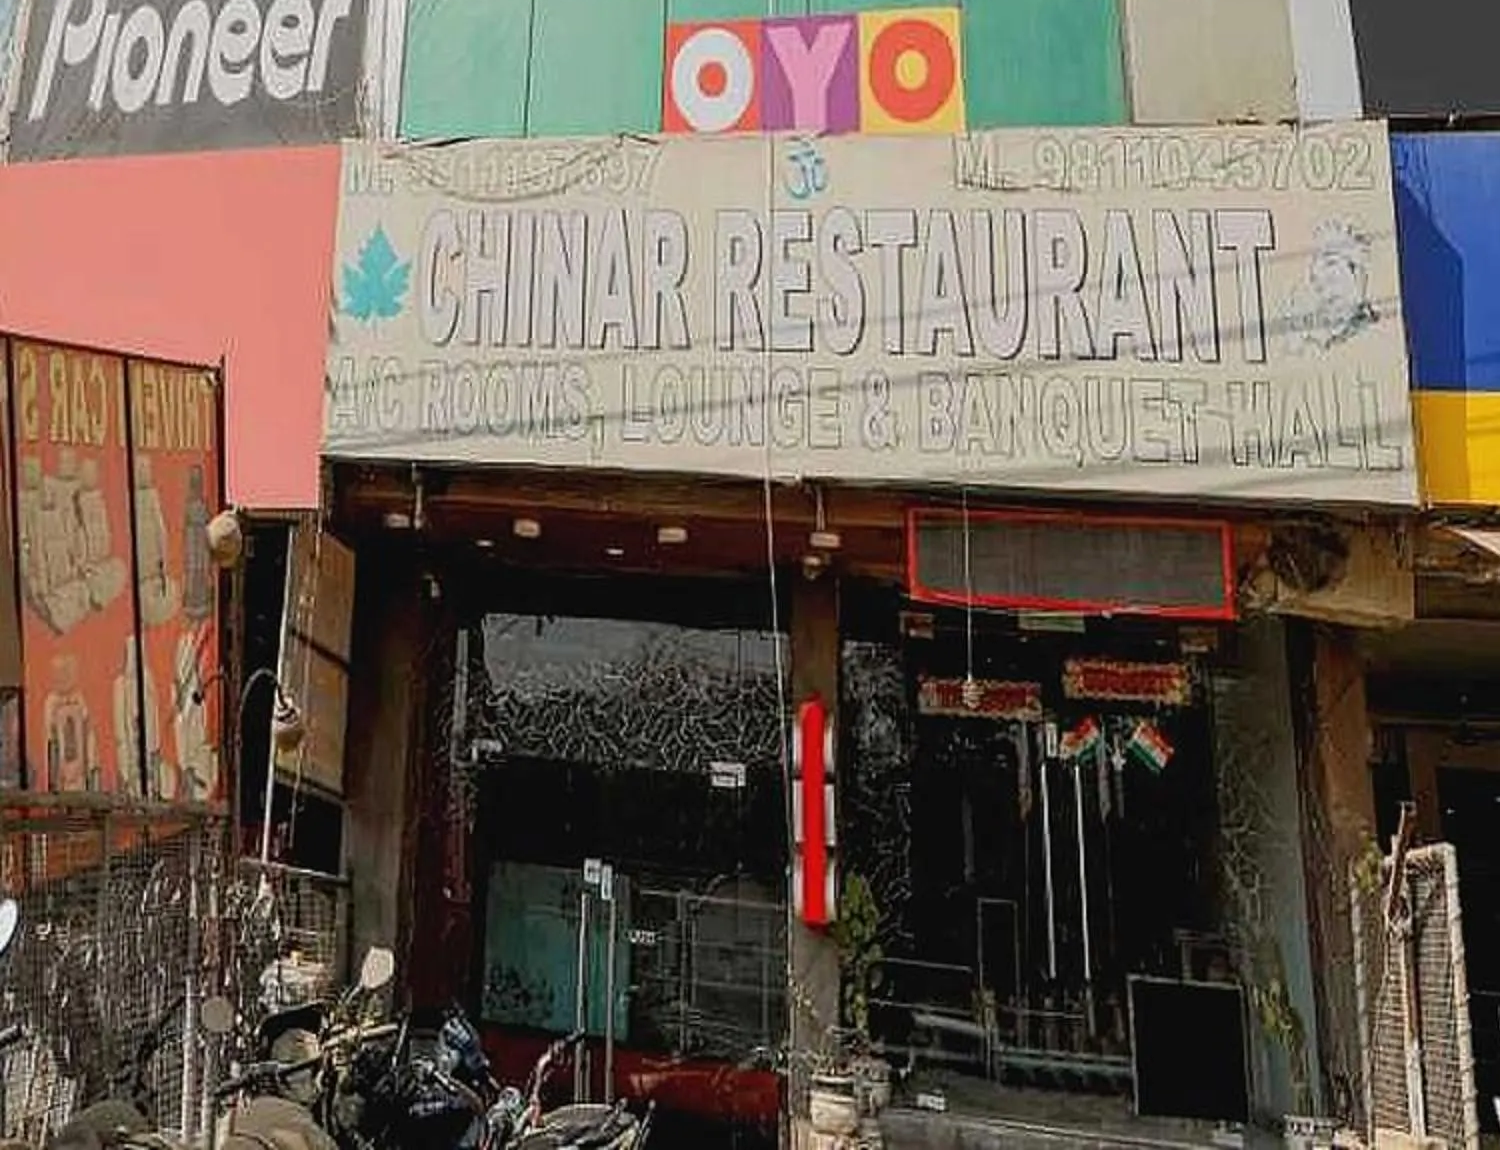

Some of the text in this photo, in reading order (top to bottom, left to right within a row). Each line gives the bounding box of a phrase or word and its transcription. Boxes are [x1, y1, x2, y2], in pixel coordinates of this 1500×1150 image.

[671, 18, 956, 134] OYO
[422, 207, 1276, 364] CHINAR RESTAURANT
[620, 363, 842, 450] LOUNGE
[862, 371, 898, 451] &
